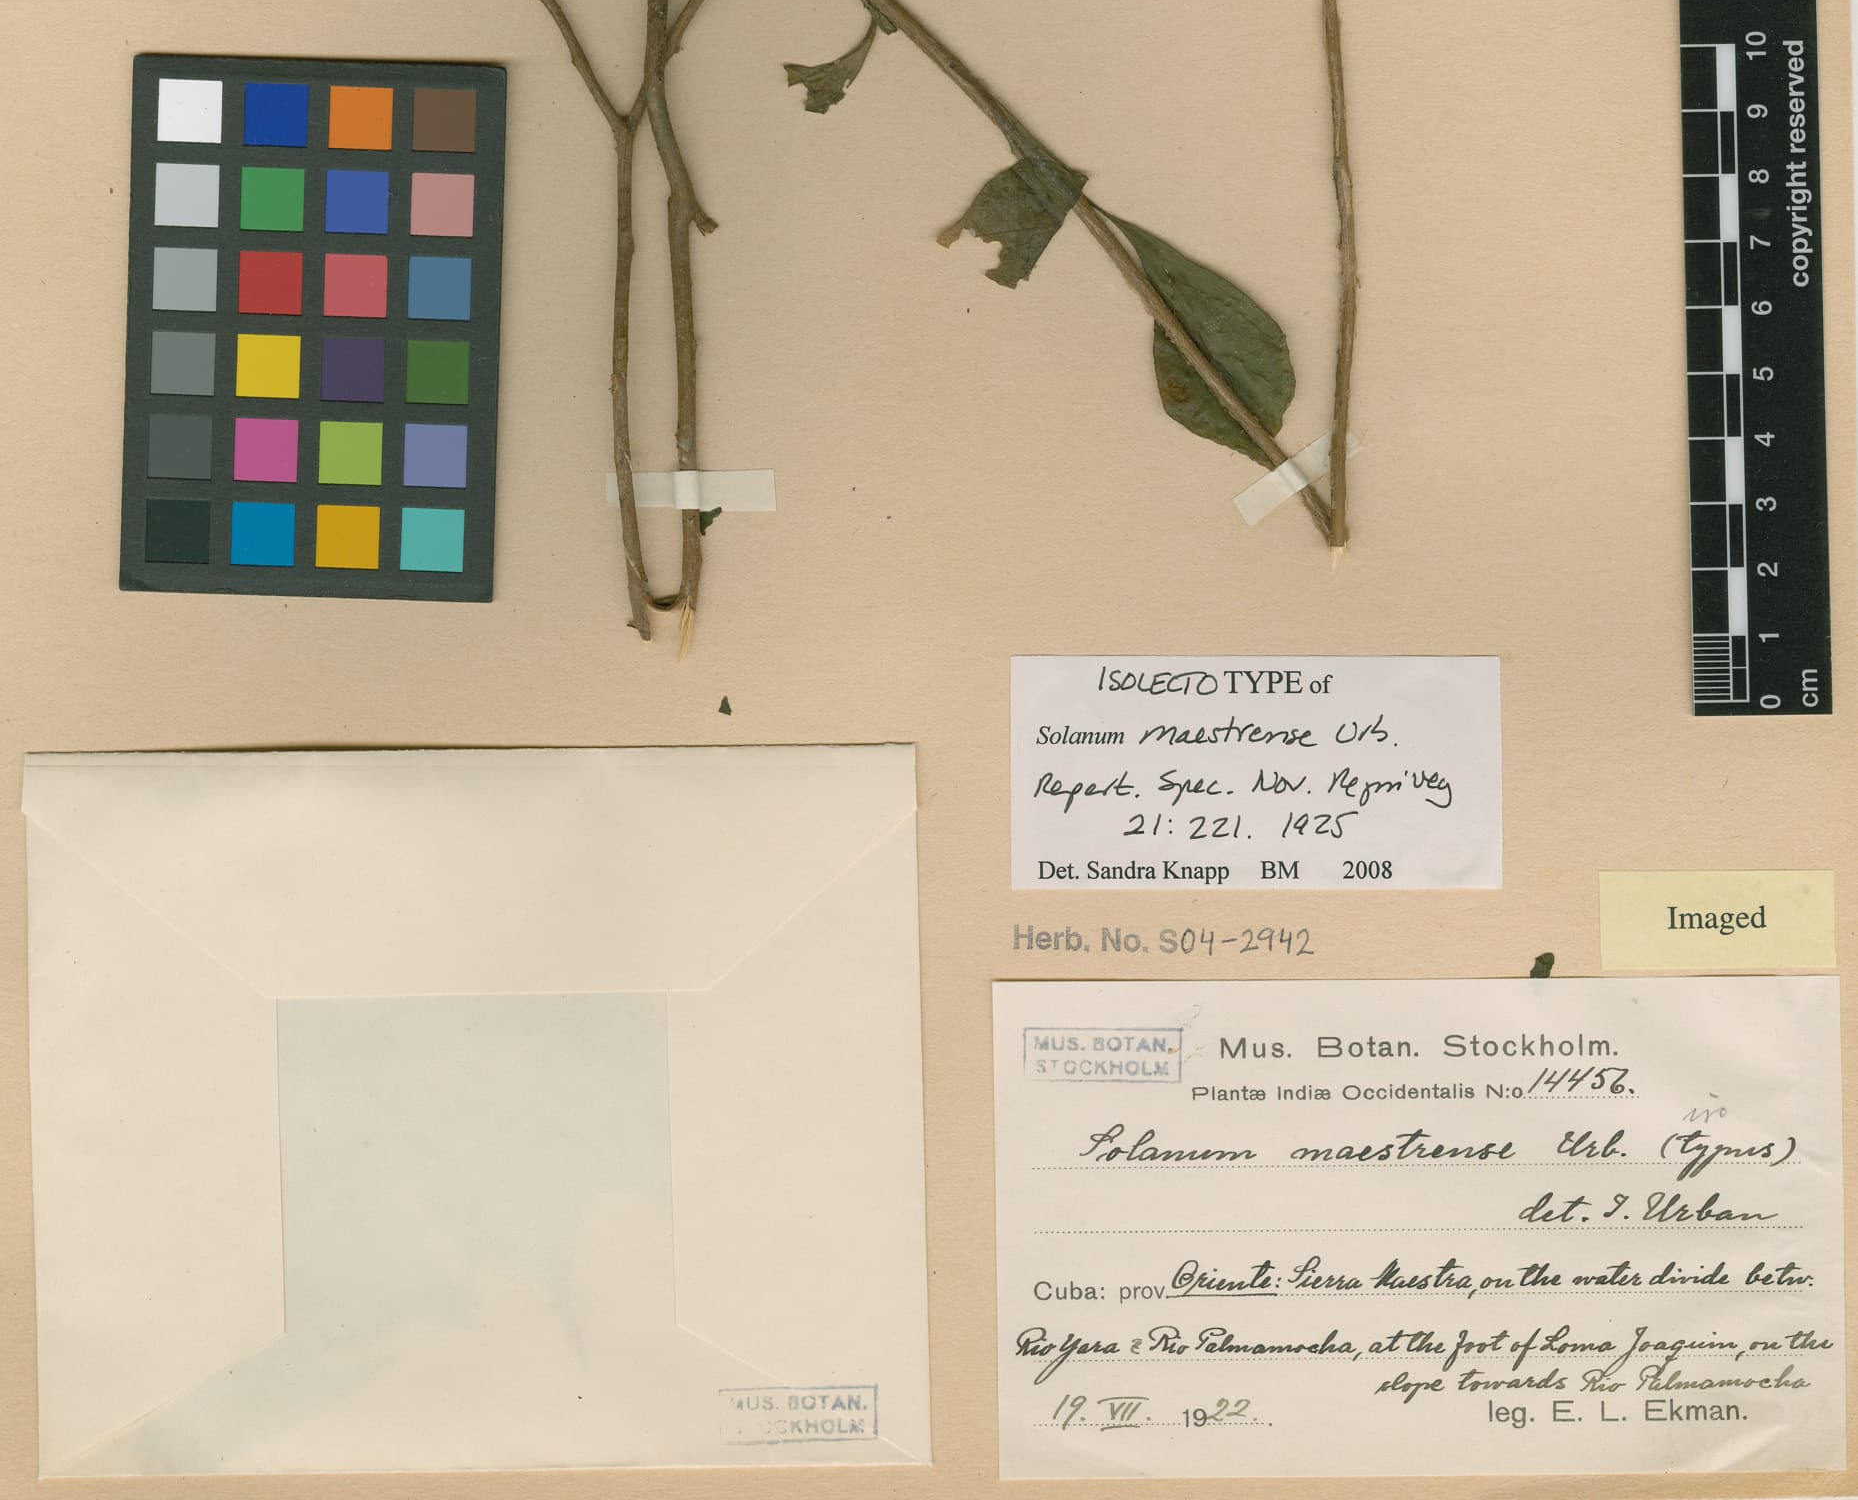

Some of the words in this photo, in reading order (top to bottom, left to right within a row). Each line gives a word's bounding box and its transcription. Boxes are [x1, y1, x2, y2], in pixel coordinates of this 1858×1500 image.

[1745, 31, 1767, 60] 10
[1782, 40, 1806, 154] reserved
[1747, 104, 1768, 119] 9
[1748, 168, 1770, 184] 8
[1785, 161, 1813, 288] copyright
[1750, 235, 1771, 250] 7
[1751, 300, 1772, 315] 6
[1753, 367, 1774, 381] 5
[1754, 431, 1775, 447] 4
[1755, 496, 1776, 512] 3
[1757, 562, 1778, 577] 2
[1759, 633, 1779, 643] 1
[1309, 674, 1333, 694] of
[1802, 668, 1818, 707] cm
[1760, 694, 1781, 709] 0
[1036, 726, 1125, 745] Solanum
[1252, 769, 1311, 794] Nov.
[1124, 814, 1174, 837] 21:
[1189, 813, 1252, 840] 221.
[1281, 811, 1358, 838] 1925
[1038, 860, 1079, 879] Det.
[1087, 860, 1156, 879] Sandra
[1162, 860, 1230, 884] Knapp
[1261, 861, 1300, 879] BM
[1343, 861, 1393, 879] 2008
[1667, 905, 1767, 935] Imaged
[1013, 924, 1090, 953] Herb.
[1101, 927, 1149, 953] No.
[1033, 1035, 1085, 1052] MUS.
[1093, 1036, 1172, 1053] BOTAN.
[1219, 1037, 1293, 1059] Mus.
[1317, 1036, 1420, 1058] Botan.
[1443, 1033, 1619, 1057] Stockholm.
[1035, 1060, 1170, 1077] STOCKHOLM
[1191, 1085, 1267, 1102] Plantæ
[1277, 1086, 1331, 1100] Indiæ
[1342, 1083, 1475, 1100] Occidentalis
[1486, 1084, 1523, 1100] N:o
[1079, 1123, 1258, 1163] Solanum
[1290, 1128, 1516, 1161] maestrense
[1518, 1192, 1590, 1224] det.
[1642, 1191, 1779, 1223] Urban
[1033, 1281, 1105, 1302] Cuba:
[1287, 1256, 1363, 1290] Sierra
[1480, 1276, 1515, 1289] on
[1517, 1262, 1562, 1287] the
[1571, 1260, 1642, 1288] water
[1648, 1261, 1730, 1288] divide
[1744, 1261, 1815, 1288] betw.
[1016, 1327, 1057, 1357] Rio
[1148, 1325, 1190, 1355] Rio
[1368, 1329, 1412, 1353] at
[1405, 1331, 1447, 1354] the
[1442, 1329, 1510, 1372] foot
[1510, 1328, 1543, 1371] of
[1540, 1325, 1616, 1355] Loma
[1749, 1338, 1783, 1351] on
[1785, 1330, 1835, 1351] the
[1374, 1372, 1445, 1404] slope
[1457, 1367, 1567, 1394] towards
[1579, 1368, 1627, 1393] Rio
[788, 1394, 868, 1411] BOTAN.
[1488, 1400, 1536, 1429] leg.
[1552, 1401, 1583, 1422] E.
[1600, 1401, 1627, 1422] L.
[1644, 1398, 1749, 1421] Ekman.
